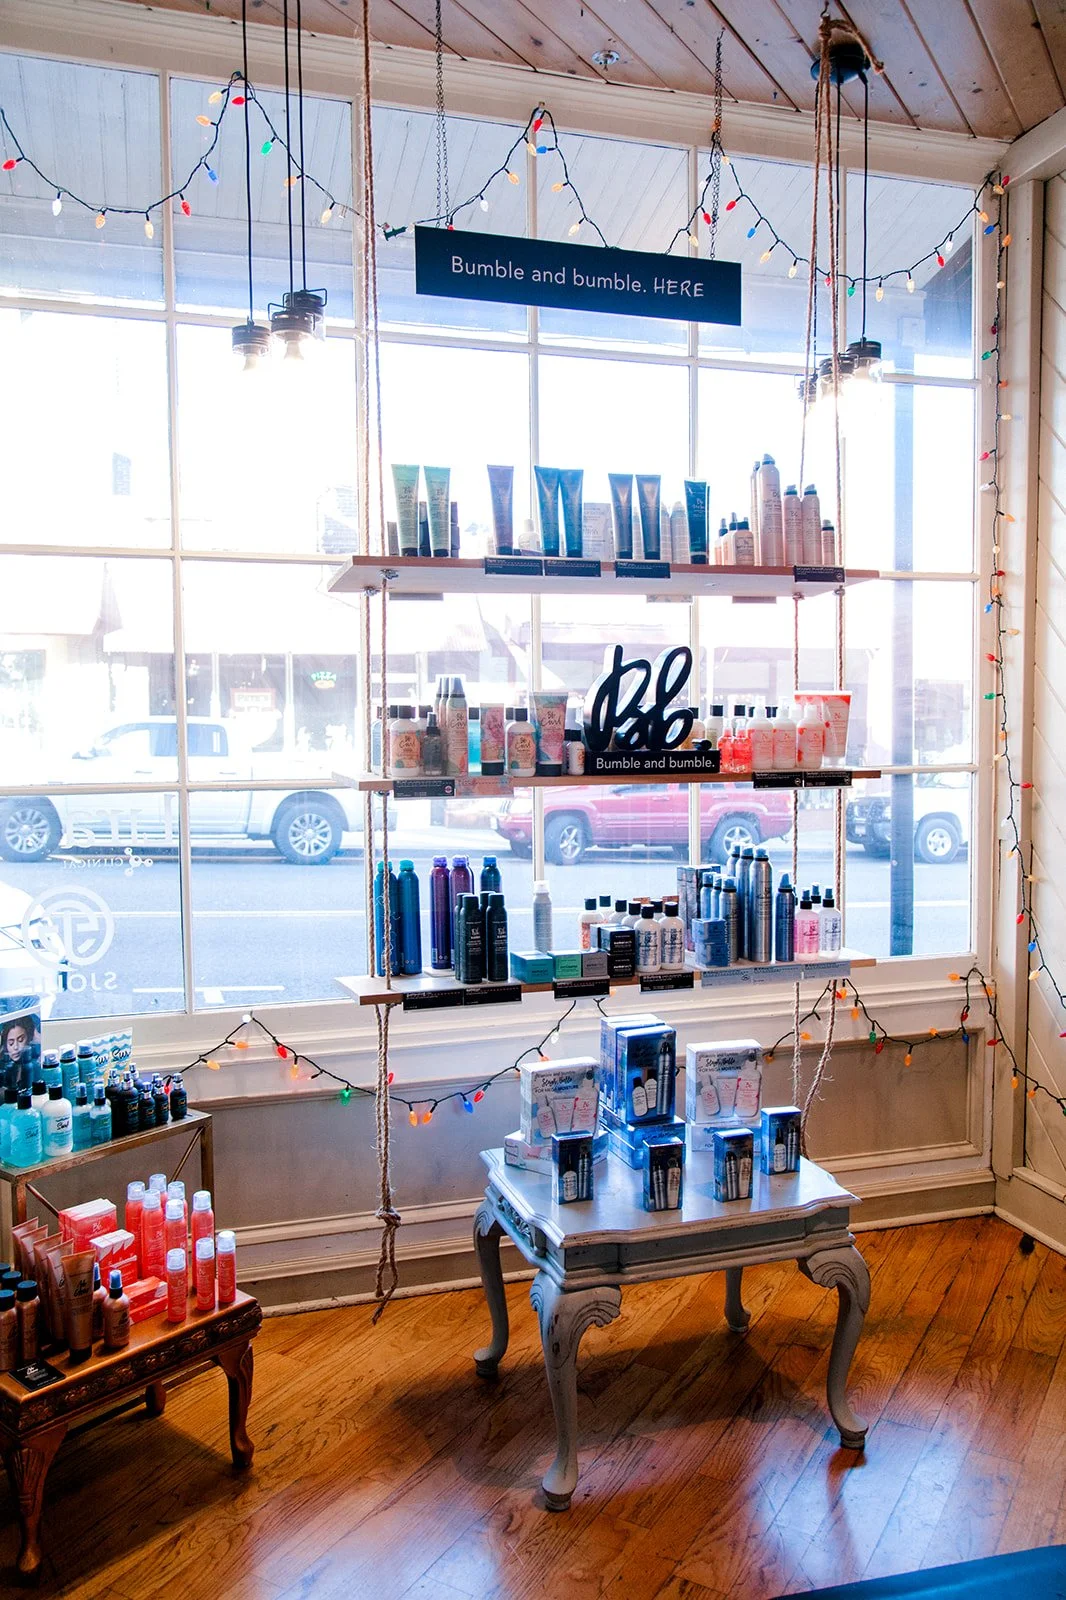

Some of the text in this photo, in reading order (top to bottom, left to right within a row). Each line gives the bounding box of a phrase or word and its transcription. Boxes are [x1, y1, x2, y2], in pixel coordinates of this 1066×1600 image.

[451, 255, 704, 297] Bumble and bumble. HERE
[596, 756, 716, 769] Bumble and bumble.
[56, 1120, 70, 1131] Surf
